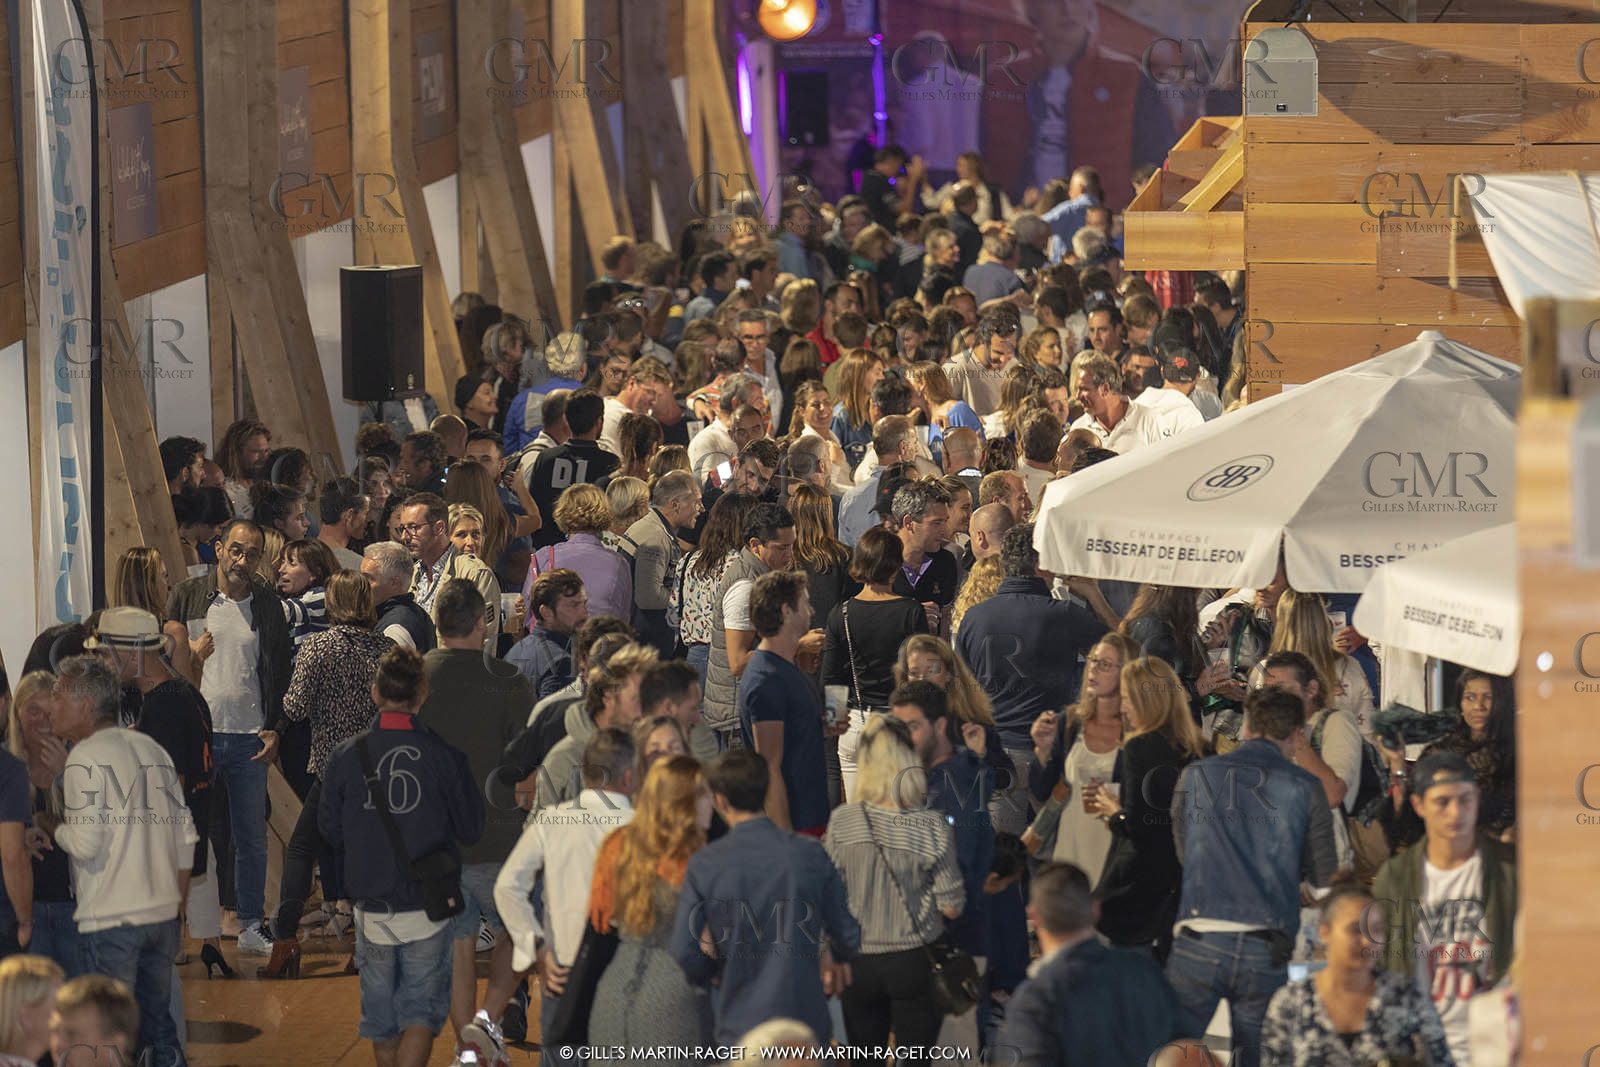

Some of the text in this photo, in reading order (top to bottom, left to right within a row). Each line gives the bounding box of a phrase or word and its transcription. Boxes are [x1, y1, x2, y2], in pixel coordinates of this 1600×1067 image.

[1086, 538, 1246, 563] BESSERAT DE BELLEFON
